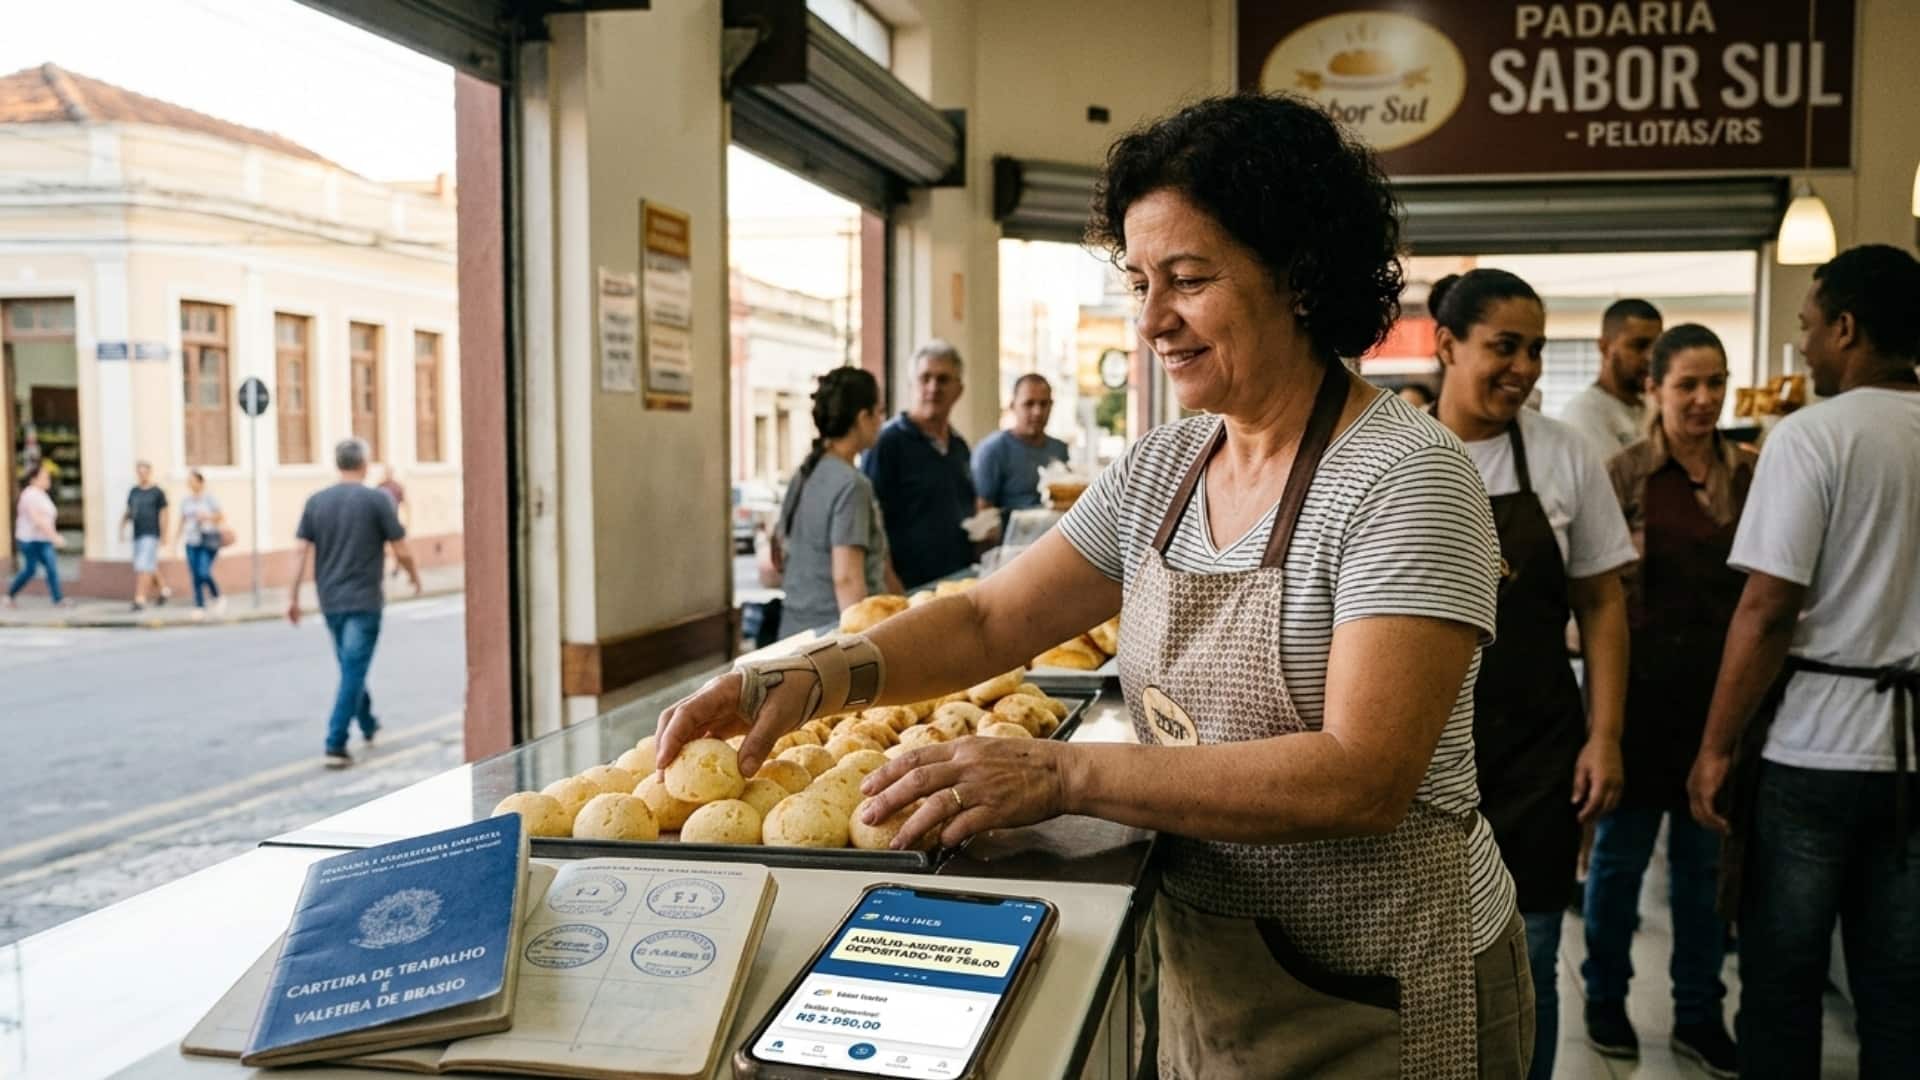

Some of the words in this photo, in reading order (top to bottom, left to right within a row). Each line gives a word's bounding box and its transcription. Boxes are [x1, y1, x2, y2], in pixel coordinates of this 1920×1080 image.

[1515, 1, 1716, 39] PADARIA
[1489, 45, 1700, 115] SABOR
[1720, 41, 1843, 110] SUL
[1327, 98, 1374, 124] bor
[1380, 95, 1430, 124] Sul
[1587, 117, 1763, 147] PELOTAS/RS
[371, 967, 394, 982] DE
[380, 980, 391, 993] E
[376, 993, 400, 1008] DE
